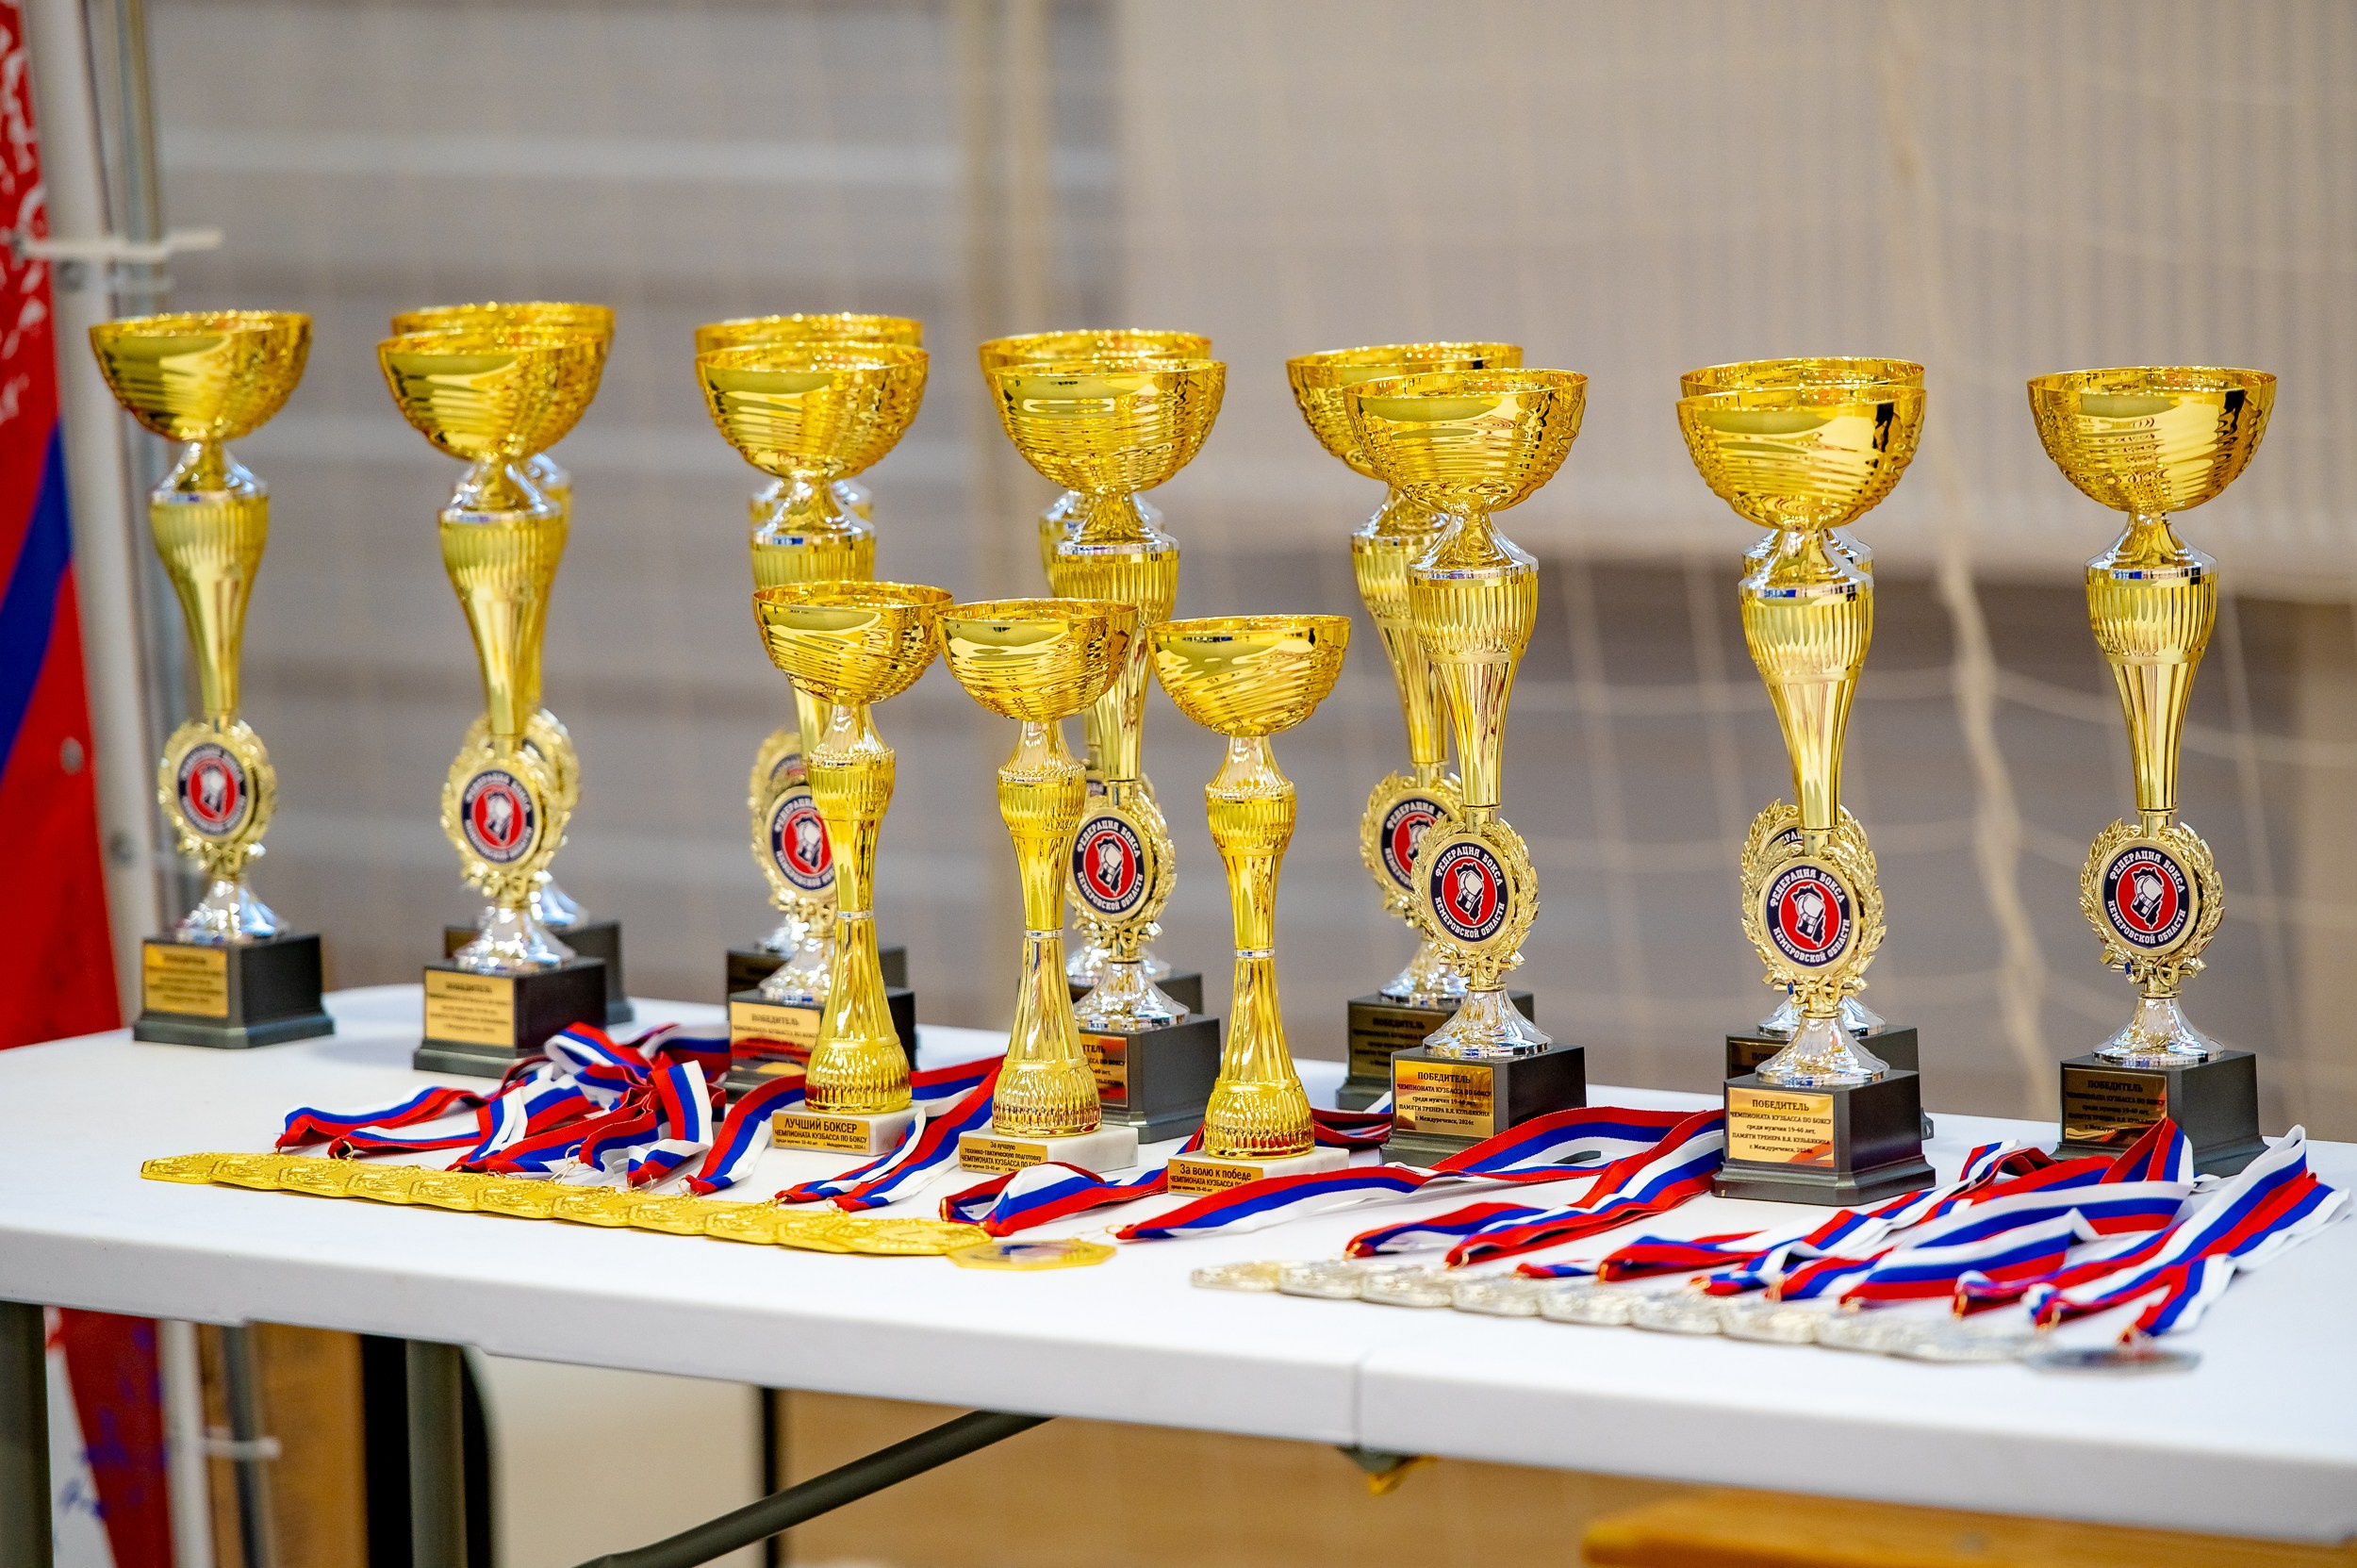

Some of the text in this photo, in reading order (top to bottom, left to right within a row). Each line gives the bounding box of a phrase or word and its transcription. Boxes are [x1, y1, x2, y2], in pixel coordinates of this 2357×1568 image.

[1077, 819, 1142, 858] ФЕДЕРАЦИЯ БОКСА
[1435, 846, 1504, 886] ФЕДЕРАЦИЯ БОКСА
[2109, 850, 2185, 894] ФЕДЕРАЦИЯ БОКСА
[1077, 870, 1144, 911] КЕМЕРОВСКОЙ ОБЛАСТИ
[1770, 867, 1846, 908] ФЕДЕРАЦИЯ БОКСА
[1434, 896, 1506, 938] КЕМЕРОВСКОЙ ОБЛАСТИ
[2107, 899, 2186, 944] КЕМЕРОВСКОЙ ОБЛАСТИ
[1772, 918, 1851, 964] КЕМЕРОВСКОЙ ОБЛАСТИ
[1417, 1071, 1471, 1084] ПОБЕДИТЕЛЬ
[1396, 1083, 1435, 1093] ЧЕМПИОНАТА
[2087, 1080, 2144, 1093] ПОБЕДИТЕЛЬ
[1752, 1098, 1810, 1112] ПОБЕДИТЕЛЬ
[1729, 1111, 1771, 1120] ЧЕМПИОНАТА
[784, 1117, 858, 1133] ЛУЧШИЙ БОКСЕР
[774, 1129, 812, 1138] ЧЕМПИОНАТА
[812, 1131, 840, 1142] КУЗБАССА
[849, 1135, 867, 1144] БОКСУ
[997, 1143, 1016, 1151] лучшую
[961, 1154, 995, 1164] ЧЕМПИОНАТА
[995, 1158, 1020, 1168] КУЗБАССА
[1179, 1163, 1252, 1182] За волю к победе
[1170, 1175, 1206, 1185] ЧЕМПИОНАТА
[1207, 1179, 1234, 1188] КУЗБАССА
